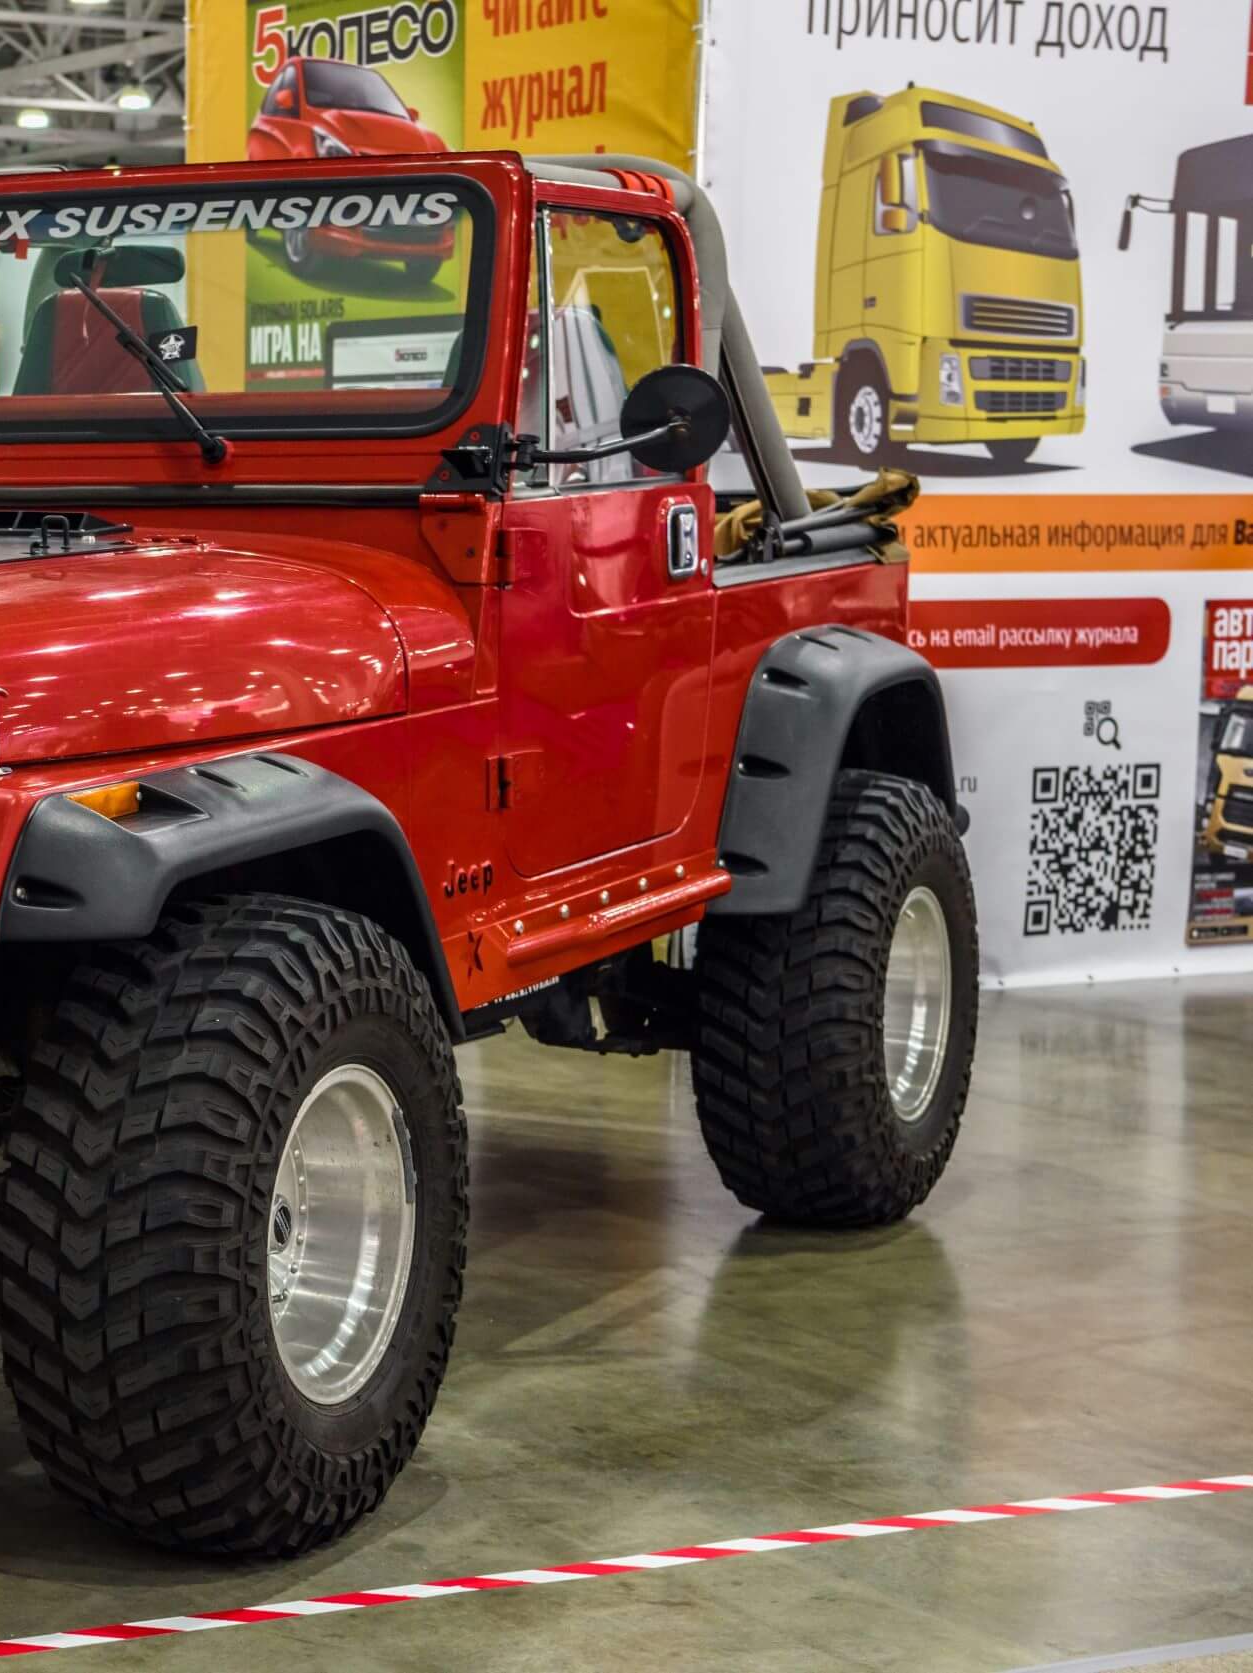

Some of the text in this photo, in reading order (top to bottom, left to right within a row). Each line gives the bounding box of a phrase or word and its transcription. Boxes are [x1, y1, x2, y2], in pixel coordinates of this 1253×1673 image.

[806, 0, 1169, 63] приносит доход
[481, 62, 608, 139] журнал
[48, 192, 458, 238] SUSPENSIONS
[250, 321, 323, 365] ИГРА НА
[913, 523, 1040, 552] актуальная
[1047, 520, 1185, 552] информация
[1190, 523, 1228, 550] для
[930, 628, 950, 647] на
[953, 624, 996, 647] email
[998, 628, 1072, 650] рассылку
[1074, 625, 1140, 648] журнала
[442, 858, 493, 898] Jeep
